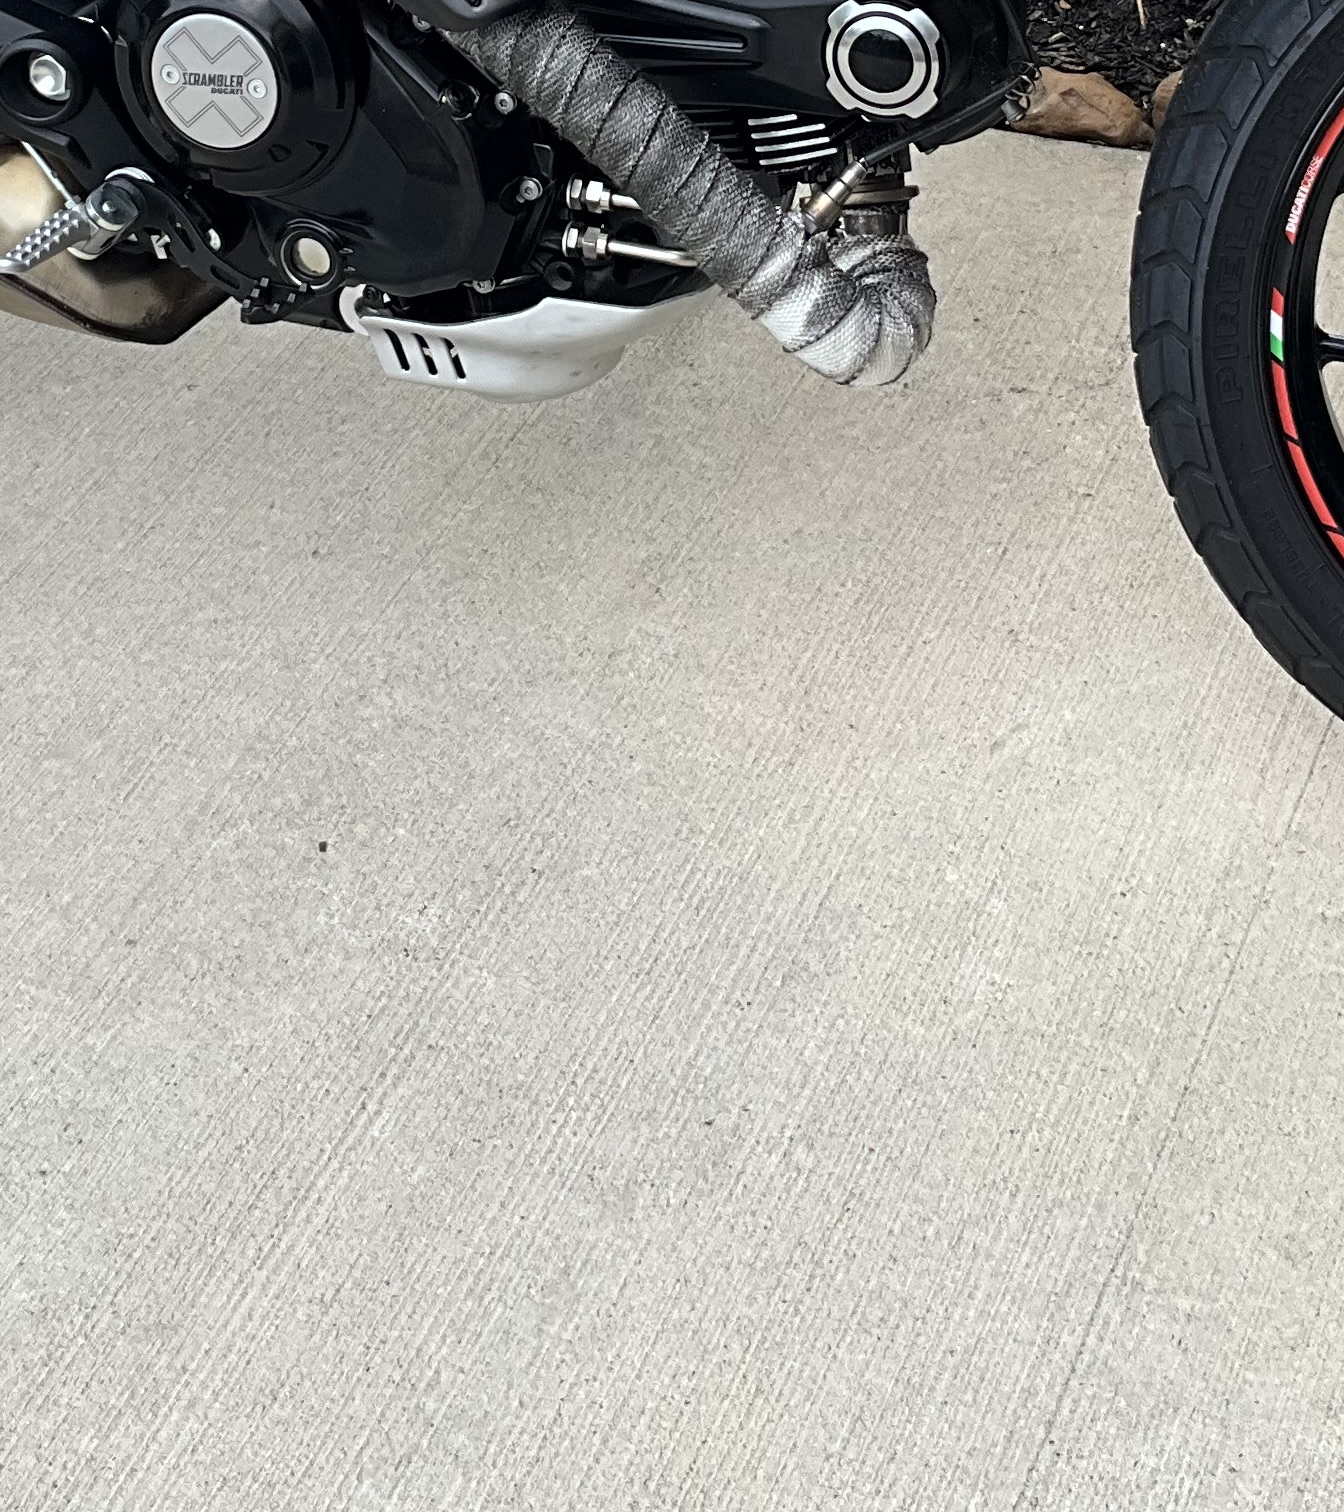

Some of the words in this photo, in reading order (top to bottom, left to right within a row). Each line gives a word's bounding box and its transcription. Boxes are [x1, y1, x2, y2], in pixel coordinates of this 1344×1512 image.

[182, 72, 244, 88] SCRAMBLER
[211, 88, 244, 96] DUCATI
[1214, 142, 1281, 405] PIRELLI
